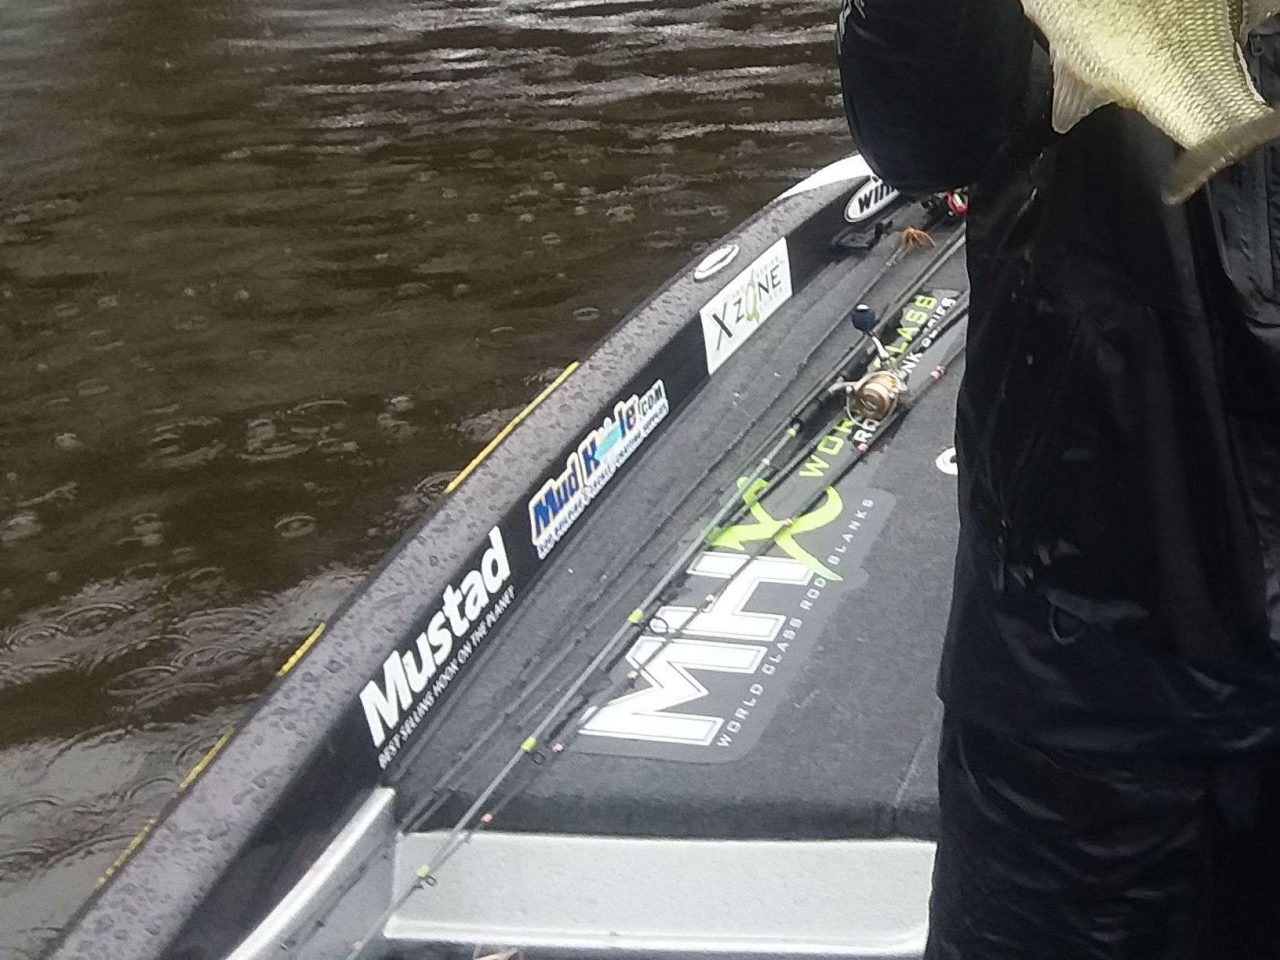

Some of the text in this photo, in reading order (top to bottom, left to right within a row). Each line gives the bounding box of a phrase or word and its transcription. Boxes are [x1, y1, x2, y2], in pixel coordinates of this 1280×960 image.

[533, 458, 580, 538] Mud
[577, 476, 843, 746] MHX
[359, 525, 511, 748] Mustad
[717, 683, 764, 747] WORLD
[799, 577, 827, 611] ROD
[827, 497, 875, 565] BLANKS
